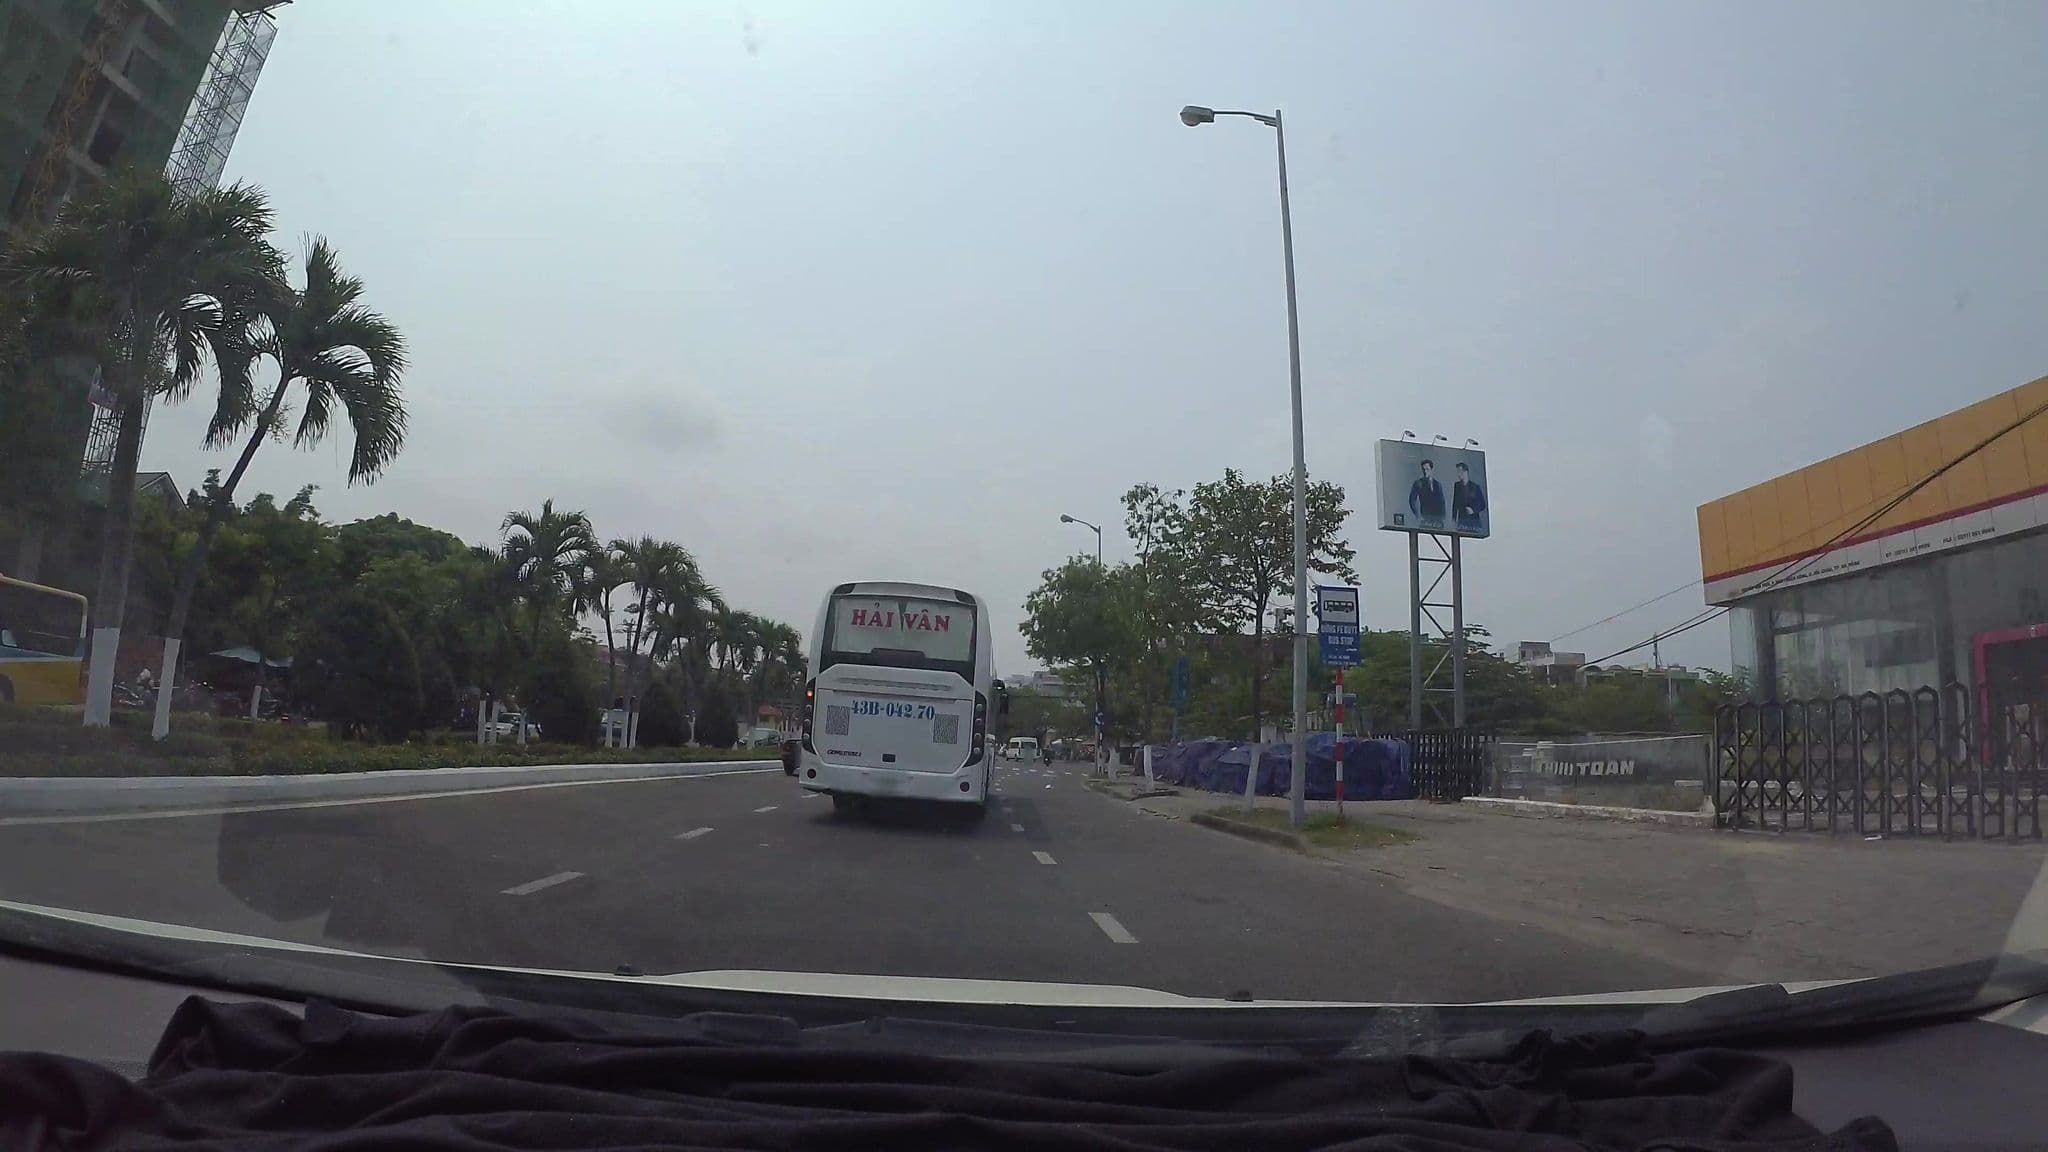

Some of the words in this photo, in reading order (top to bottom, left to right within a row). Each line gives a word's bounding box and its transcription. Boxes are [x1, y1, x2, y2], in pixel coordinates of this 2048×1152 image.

[851, 602, 895, 628] HẢI
[903, 609, 951, 633] VÂN
[851, 700, 936, 721] 43B-042.70
